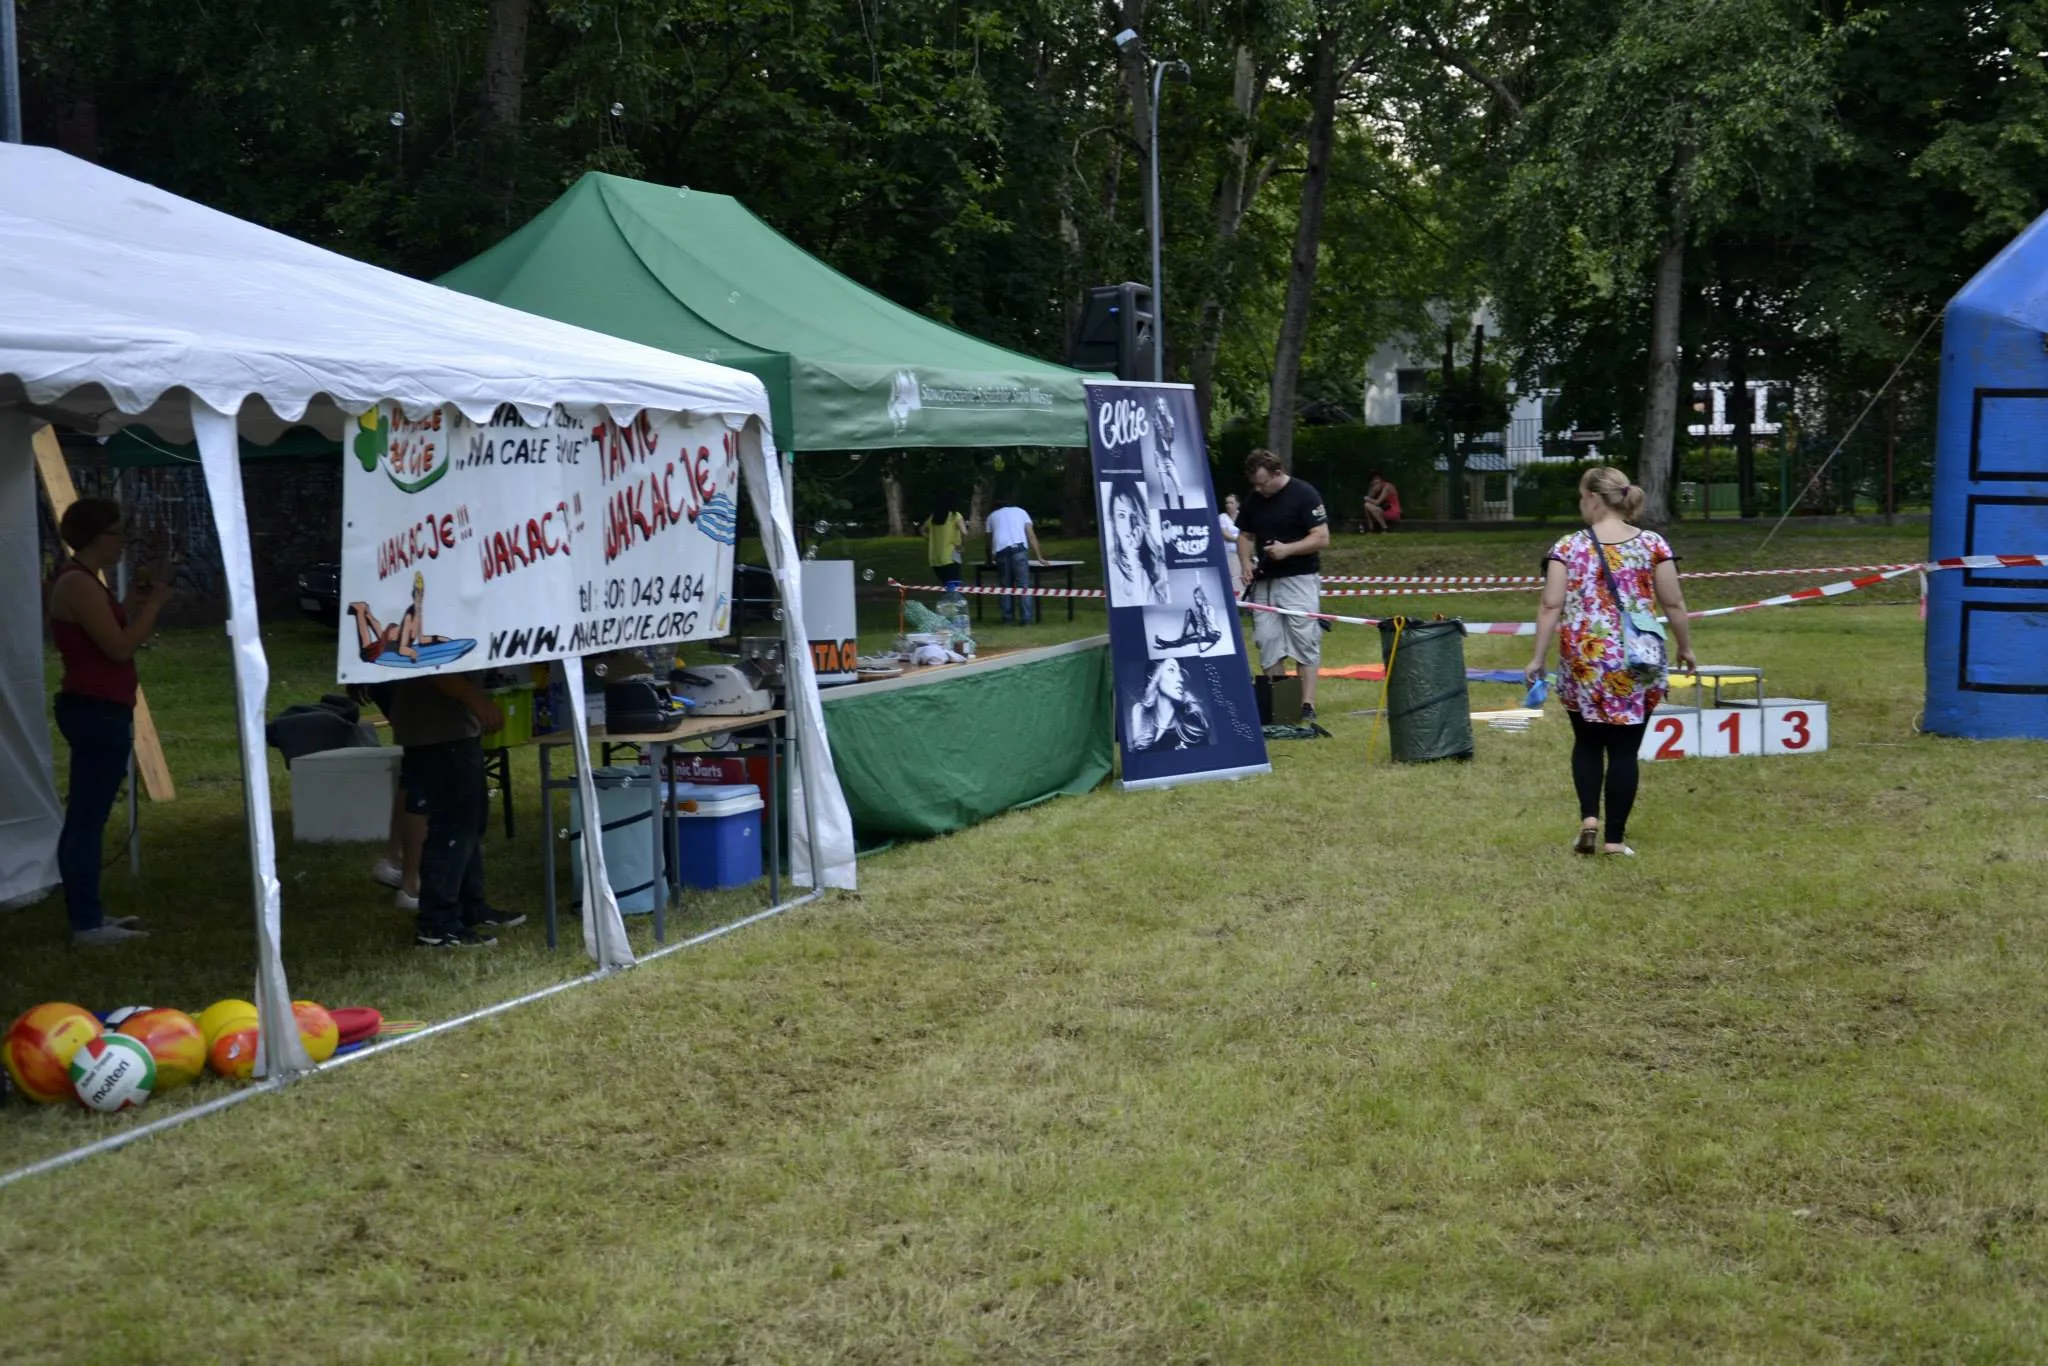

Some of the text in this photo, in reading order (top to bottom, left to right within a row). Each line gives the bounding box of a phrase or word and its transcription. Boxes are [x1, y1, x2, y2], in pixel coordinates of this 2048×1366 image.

[1099, 399, 1149, 450] Ellie
[631, 575, 664, 606] 043
[669, 573, 705, 604] 484
[1654, 717, 1685, 760] 2
[1718, 712, 1741, 754] 1
[1781, 710, 1811, 749] 3
[92, 1059, 130, 1104] molten
